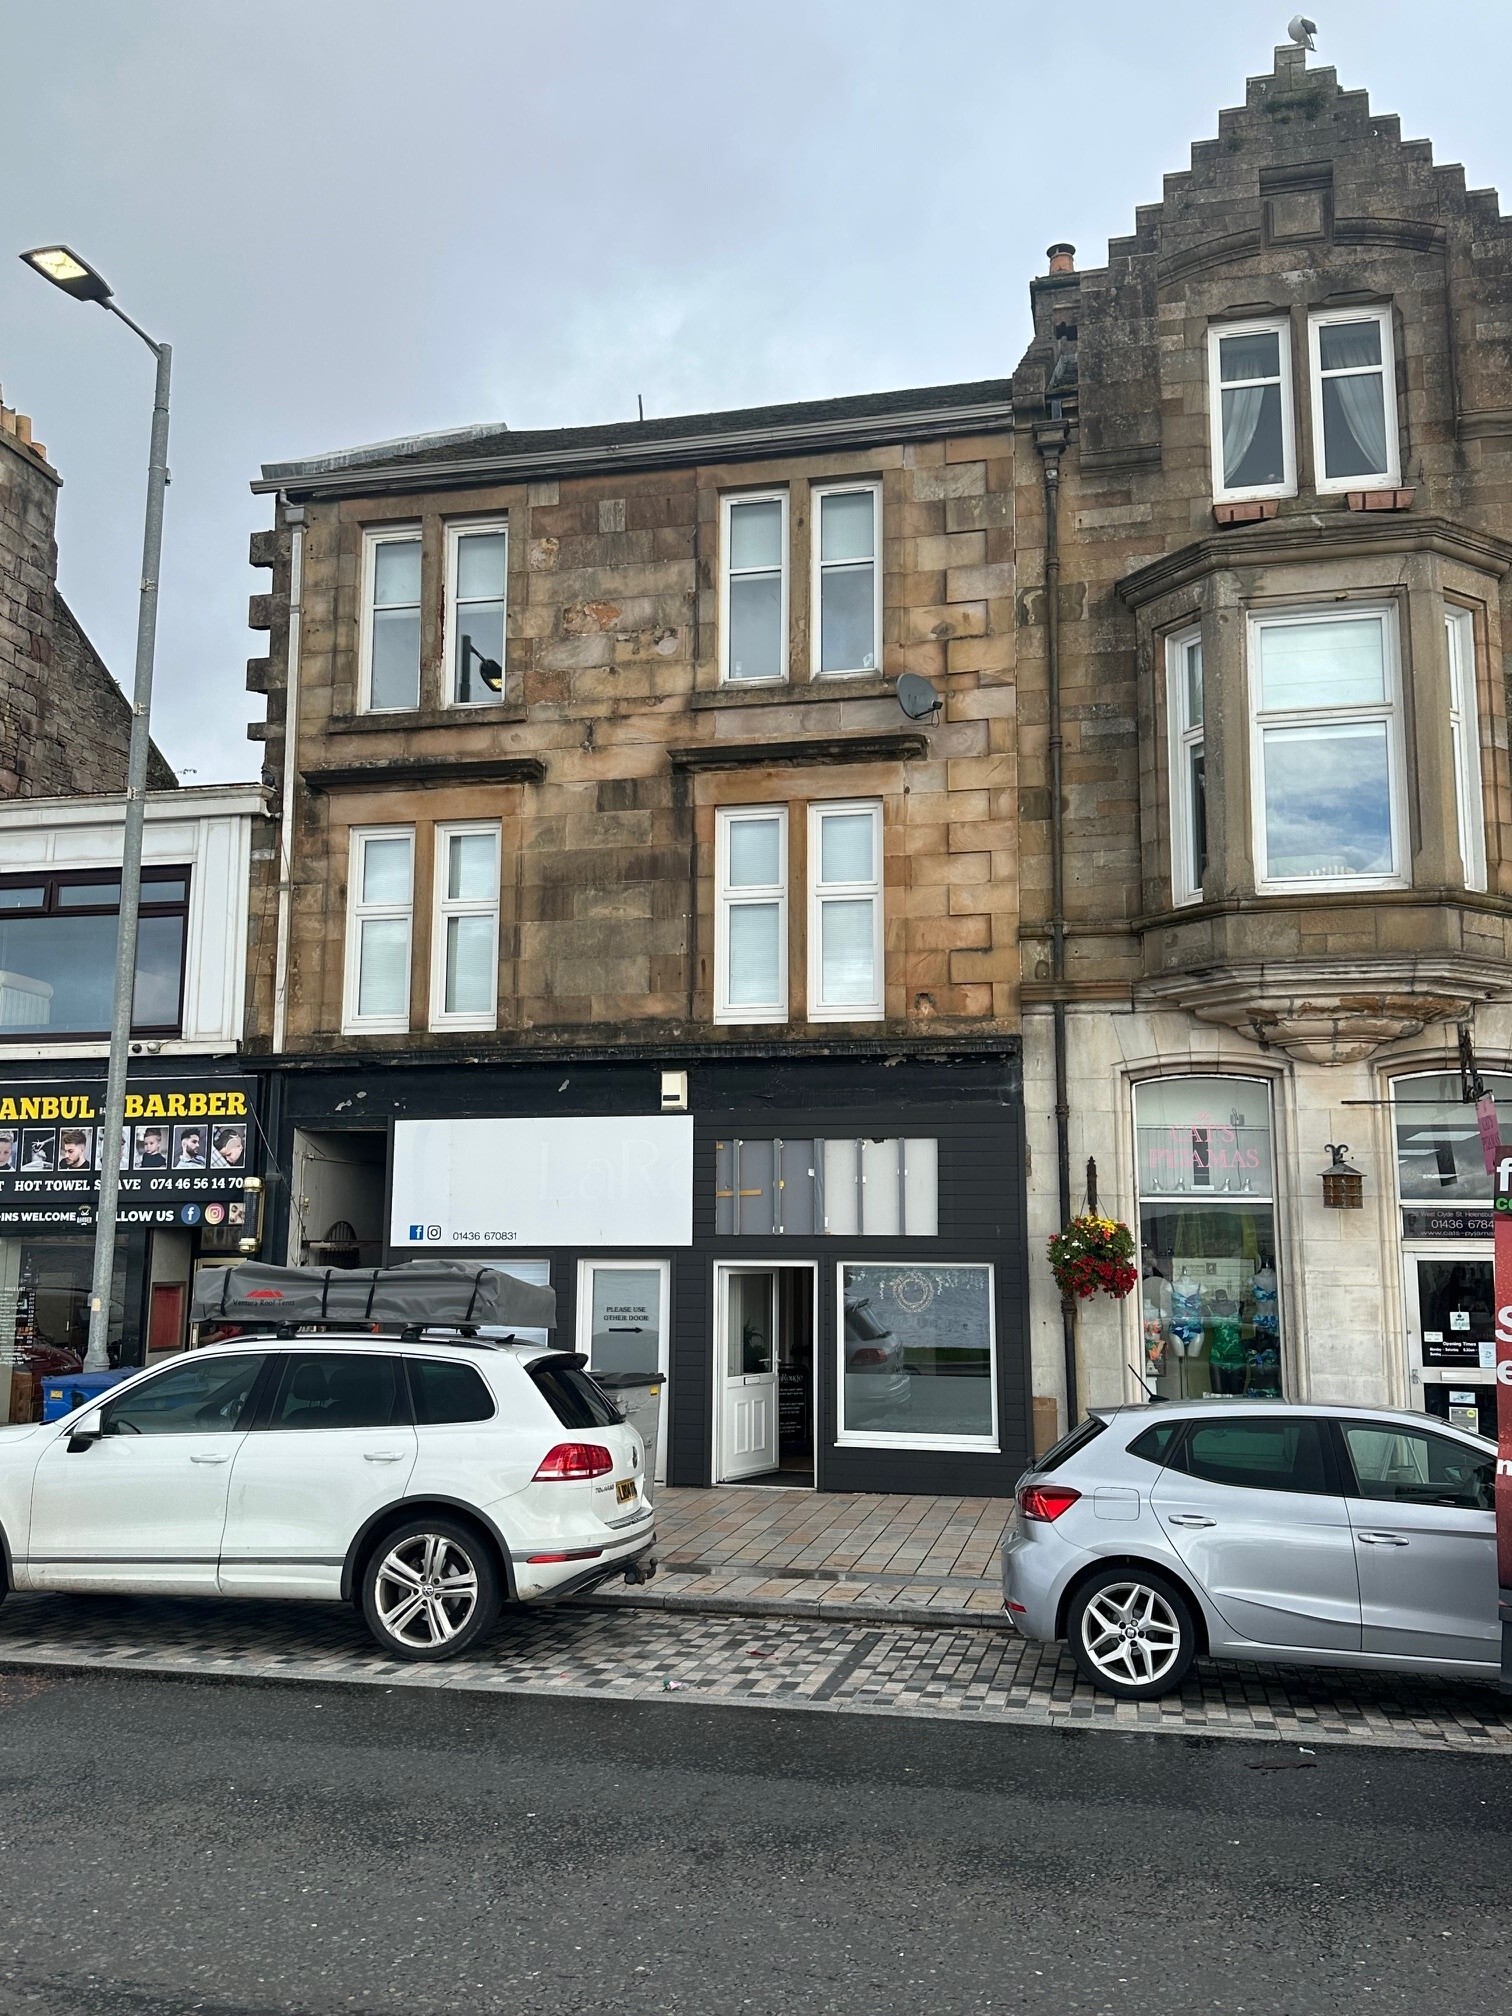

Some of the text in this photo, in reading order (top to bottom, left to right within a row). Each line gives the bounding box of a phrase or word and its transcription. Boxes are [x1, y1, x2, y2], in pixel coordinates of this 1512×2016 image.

[0, 1092, 248, 1120] ANBUL BARBER
[1149, 1146, 1260, 1169] PYJAMAS
[14, 1180, 42, 1192] HOT
[45, 1179, 91, 1191] TOWEL
[150, 1178, 173, 1190] 074
[175, 1178, 191, 1189] 46
[193, 1178, 209, 1189] 56
[211, 1177, 226, 1189] 14
[228, 1177, 244, 1189] 70
[21, 1211, 77, 1222] WELCOME
[95, 1210, 175, 1222] LLOW US
[1431, 1219, 1464, 1229] 01436
[452, 1231, 517, 1241] 01436 670831
[233, 1299, 258, 1307] Ventura
[260, 1299, 276, 1307] Roof
